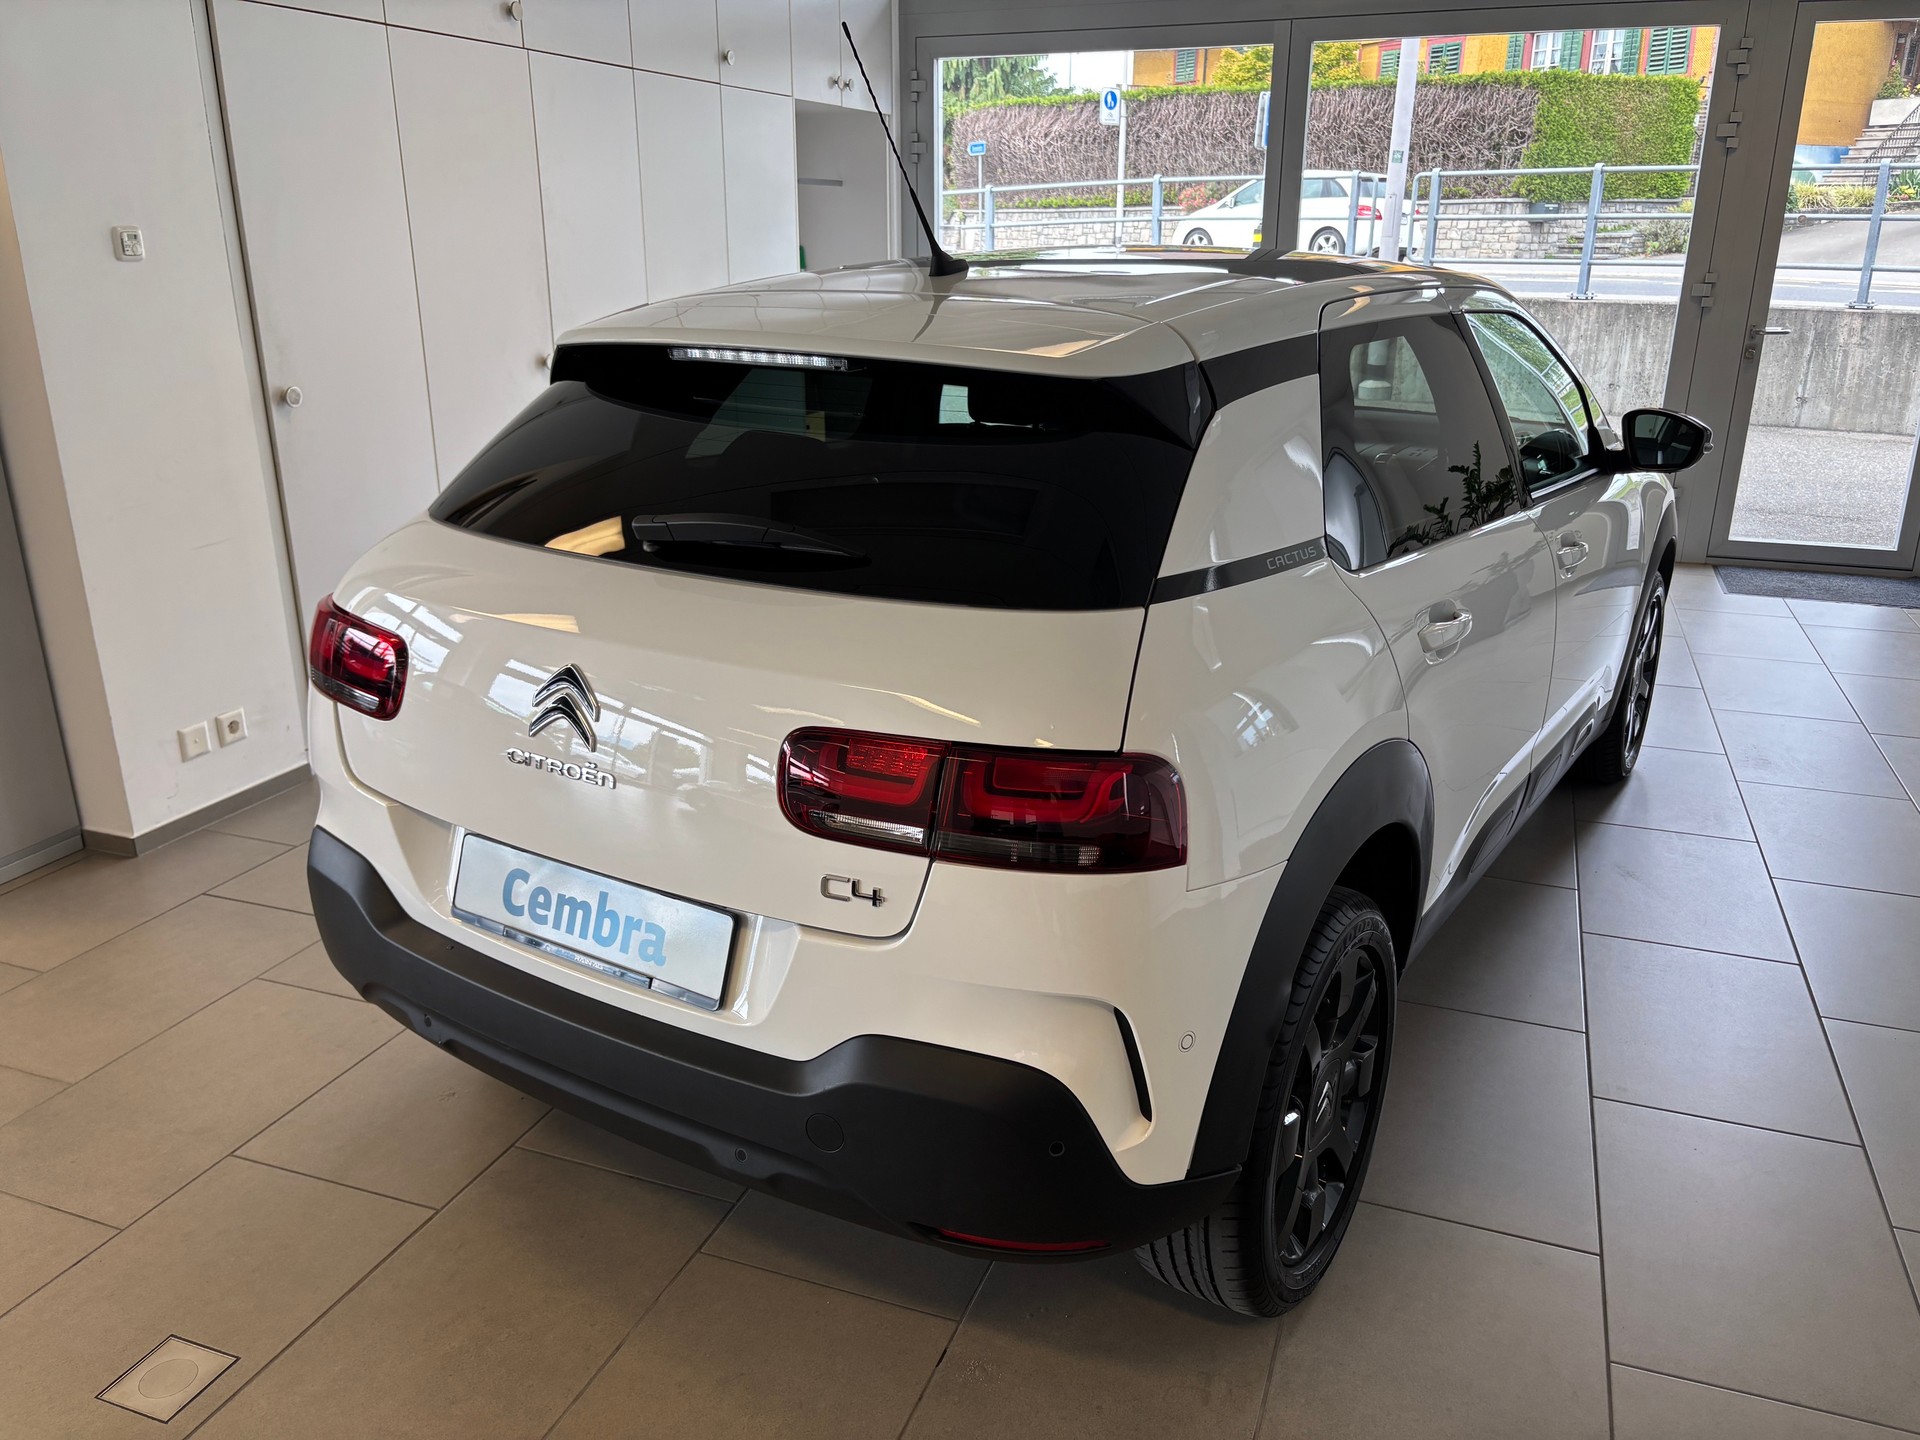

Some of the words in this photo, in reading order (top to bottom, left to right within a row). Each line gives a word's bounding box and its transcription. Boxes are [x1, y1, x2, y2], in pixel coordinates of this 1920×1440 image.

[1266, 546, 1317, 570] CACTUS
[820, 873, 886, 908] C4
[502, 867, 668, 967] Cembra
